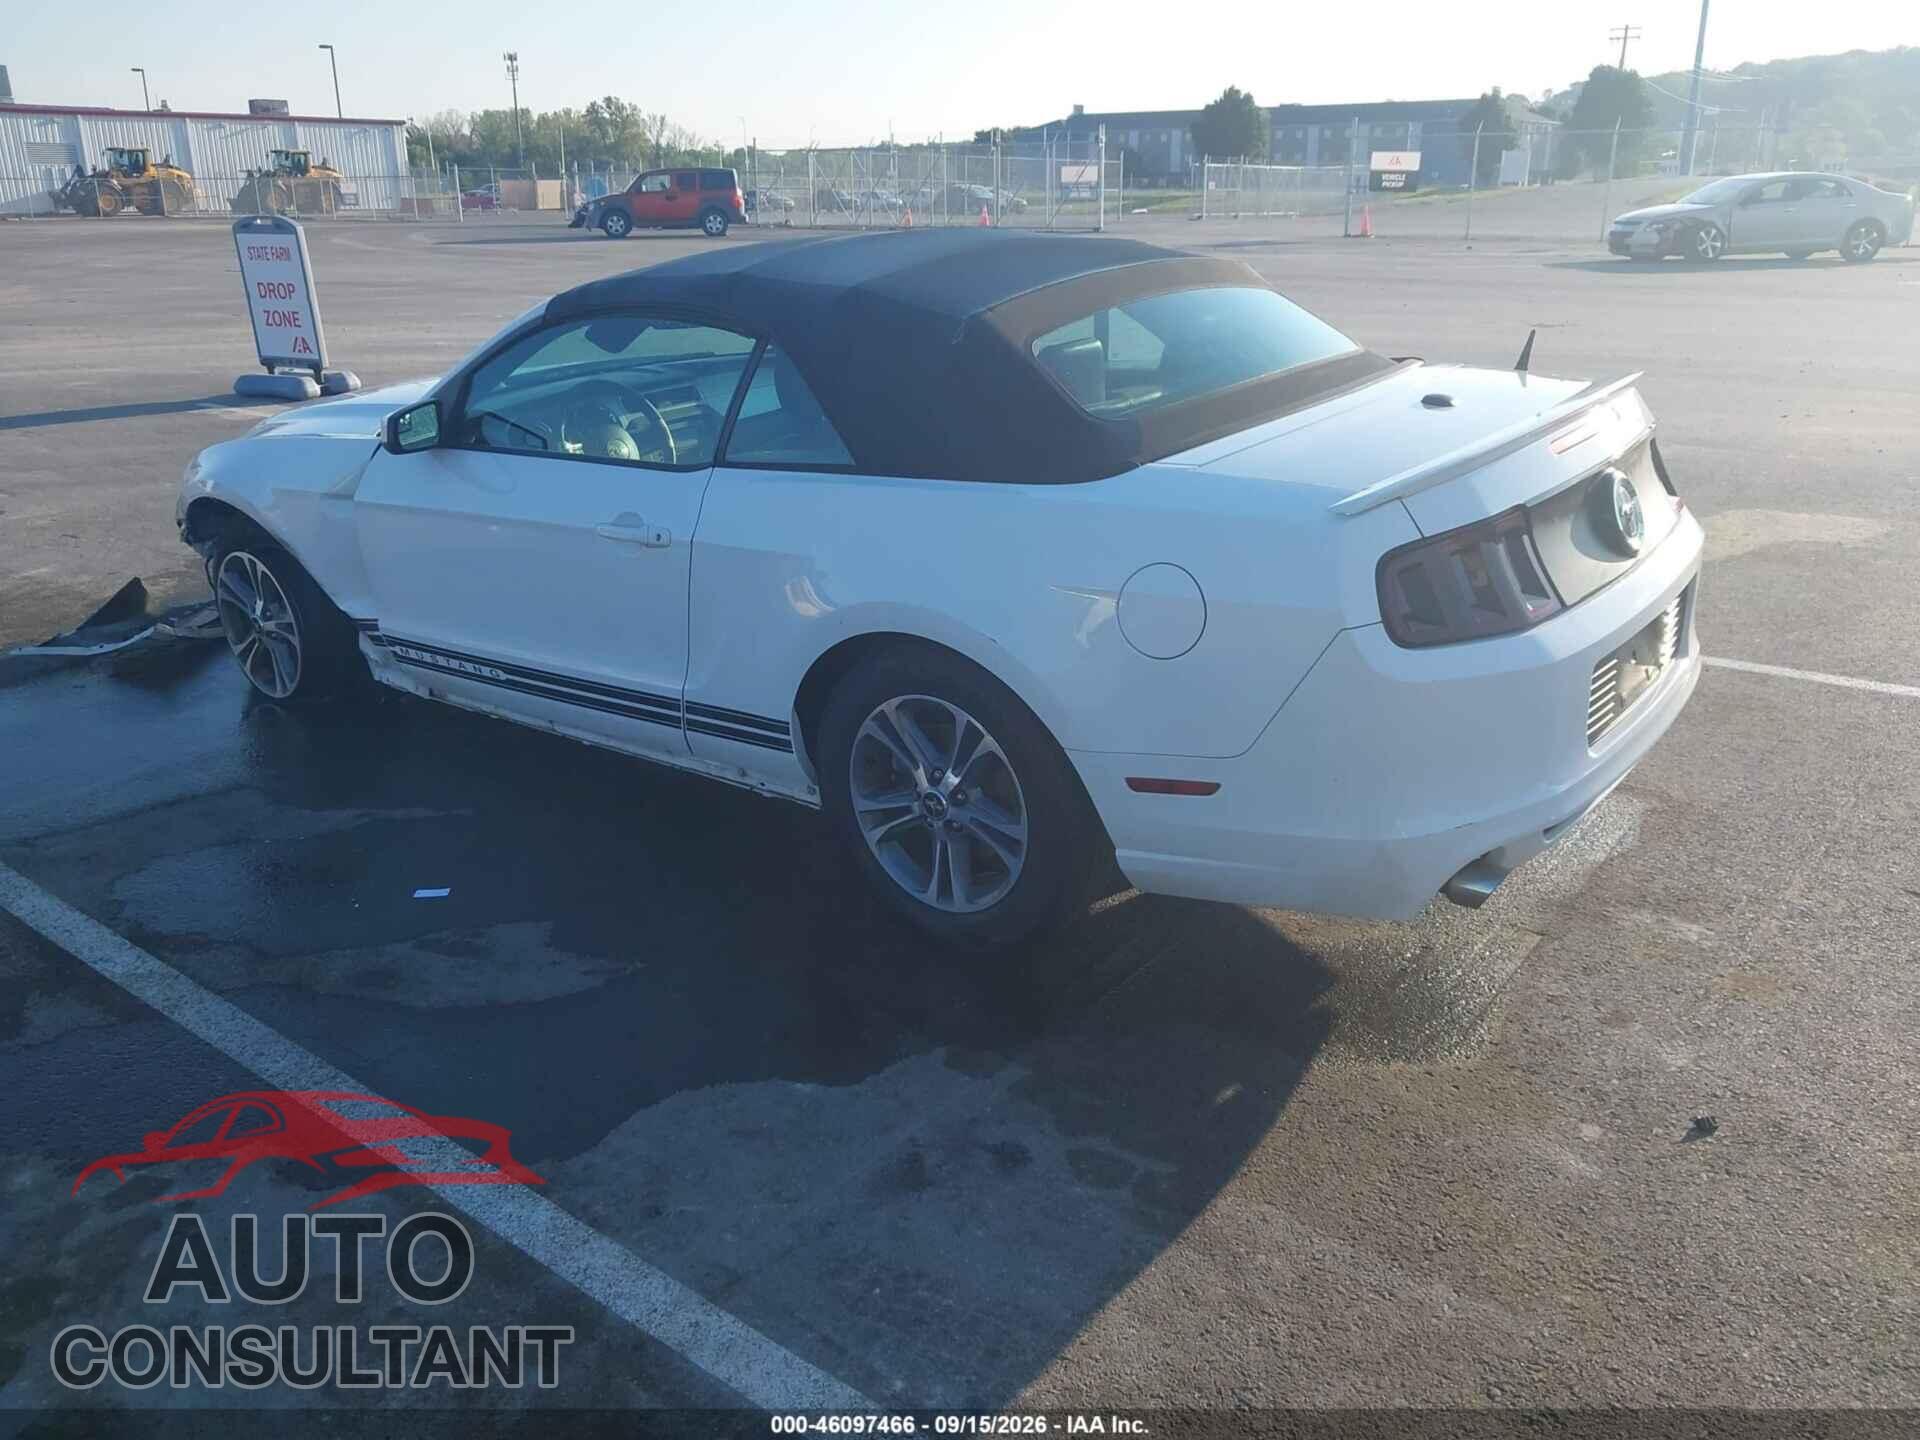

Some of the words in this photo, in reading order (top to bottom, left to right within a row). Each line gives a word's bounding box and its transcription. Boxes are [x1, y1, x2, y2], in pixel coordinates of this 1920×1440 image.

[247, 246, 269, 261] STATE
[270, 246, 290, 261] FARM
[257, 281, 296, 300] DROP
[263, 310, 302, 328] ZONE
[399, 647, 501, 678] MUSTANG
